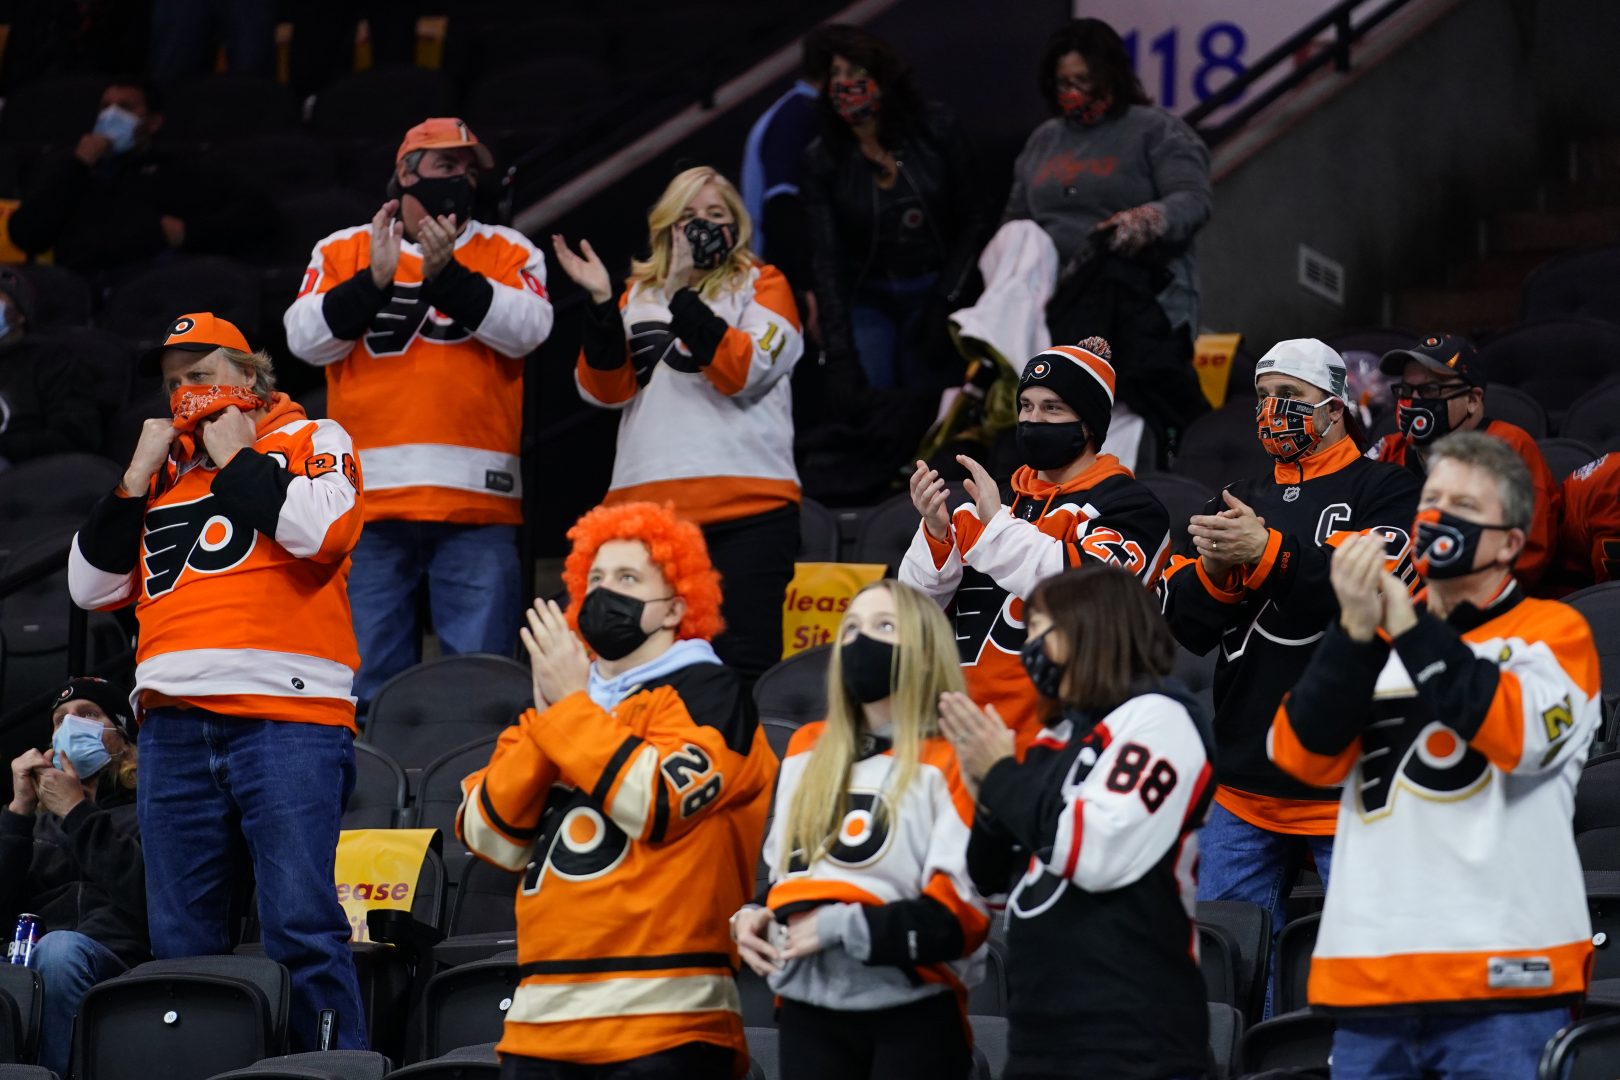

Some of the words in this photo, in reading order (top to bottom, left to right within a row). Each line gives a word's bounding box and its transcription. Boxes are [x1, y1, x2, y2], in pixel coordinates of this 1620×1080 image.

[1314, 502, 1352, 547] C
[660, 743, 725, 819] 28
[1105, 743, 1178, 815] 88
